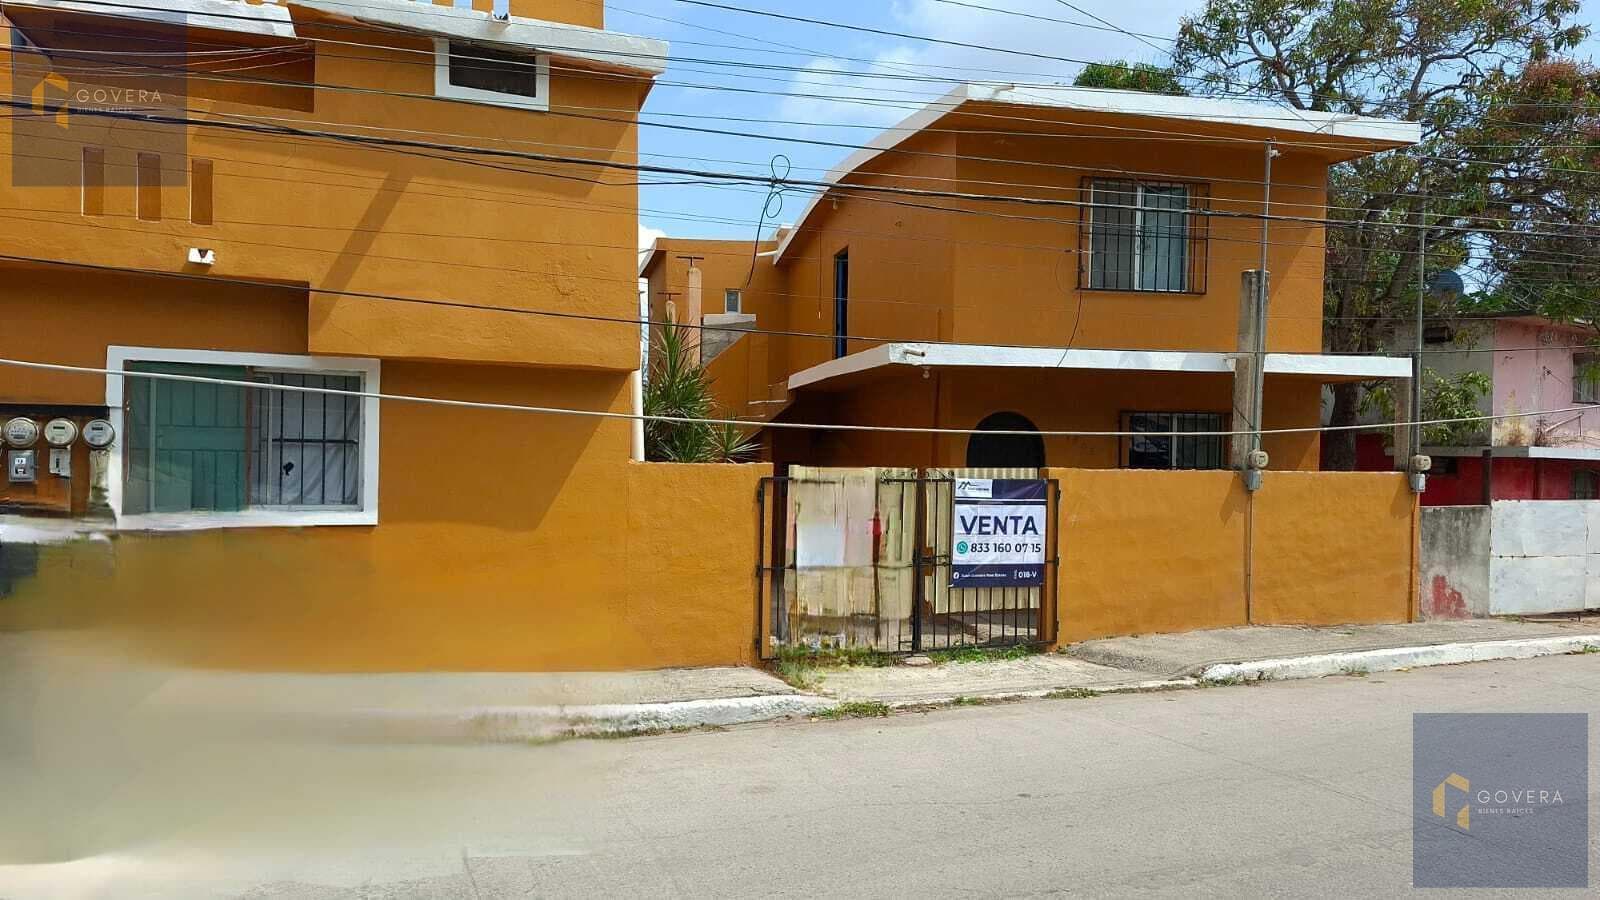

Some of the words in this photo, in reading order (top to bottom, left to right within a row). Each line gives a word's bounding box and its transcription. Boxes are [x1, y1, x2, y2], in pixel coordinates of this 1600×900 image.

[959, 515, 1039, 535] VENTA
[970, 543, 990, 553] 833
[993, 543, 1012, 553] 160
[1015, 543, 1028, 553] 07
[1031, 543, 1041, 553] 15
